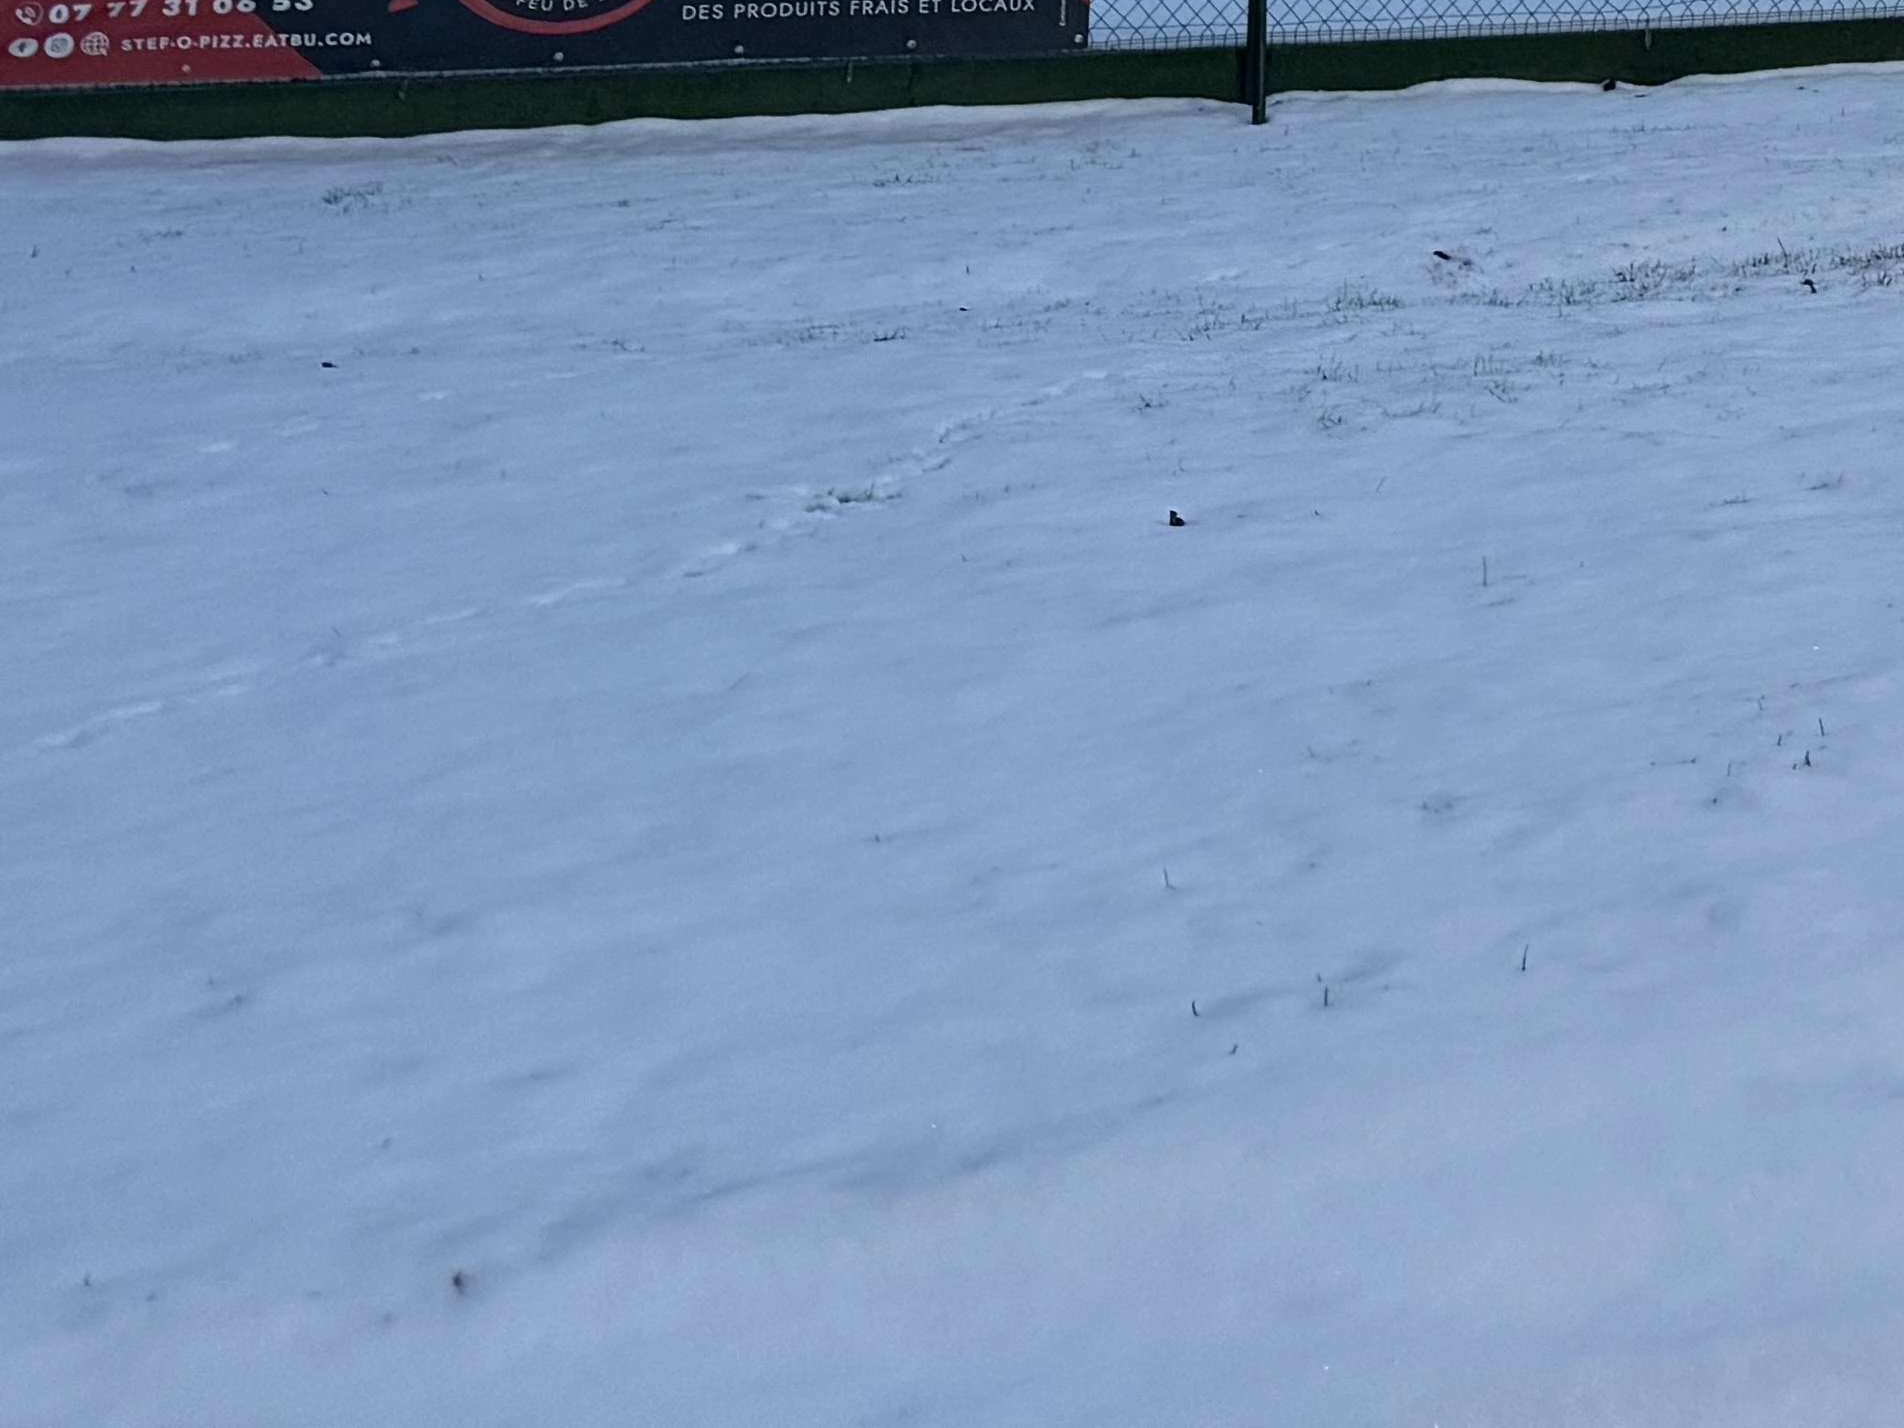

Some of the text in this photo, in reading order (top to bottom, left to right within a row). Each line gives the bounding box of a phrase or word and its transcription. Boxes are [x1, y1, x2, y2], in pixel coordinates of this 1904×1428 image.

[49, 3, 93, 24] 07
[682, 4, 724, 21] DES
[733, 0, 841, 20] PRODUITS
[120, 32, 373, 53] STEF-O-PIZZ.EATBU.COM
